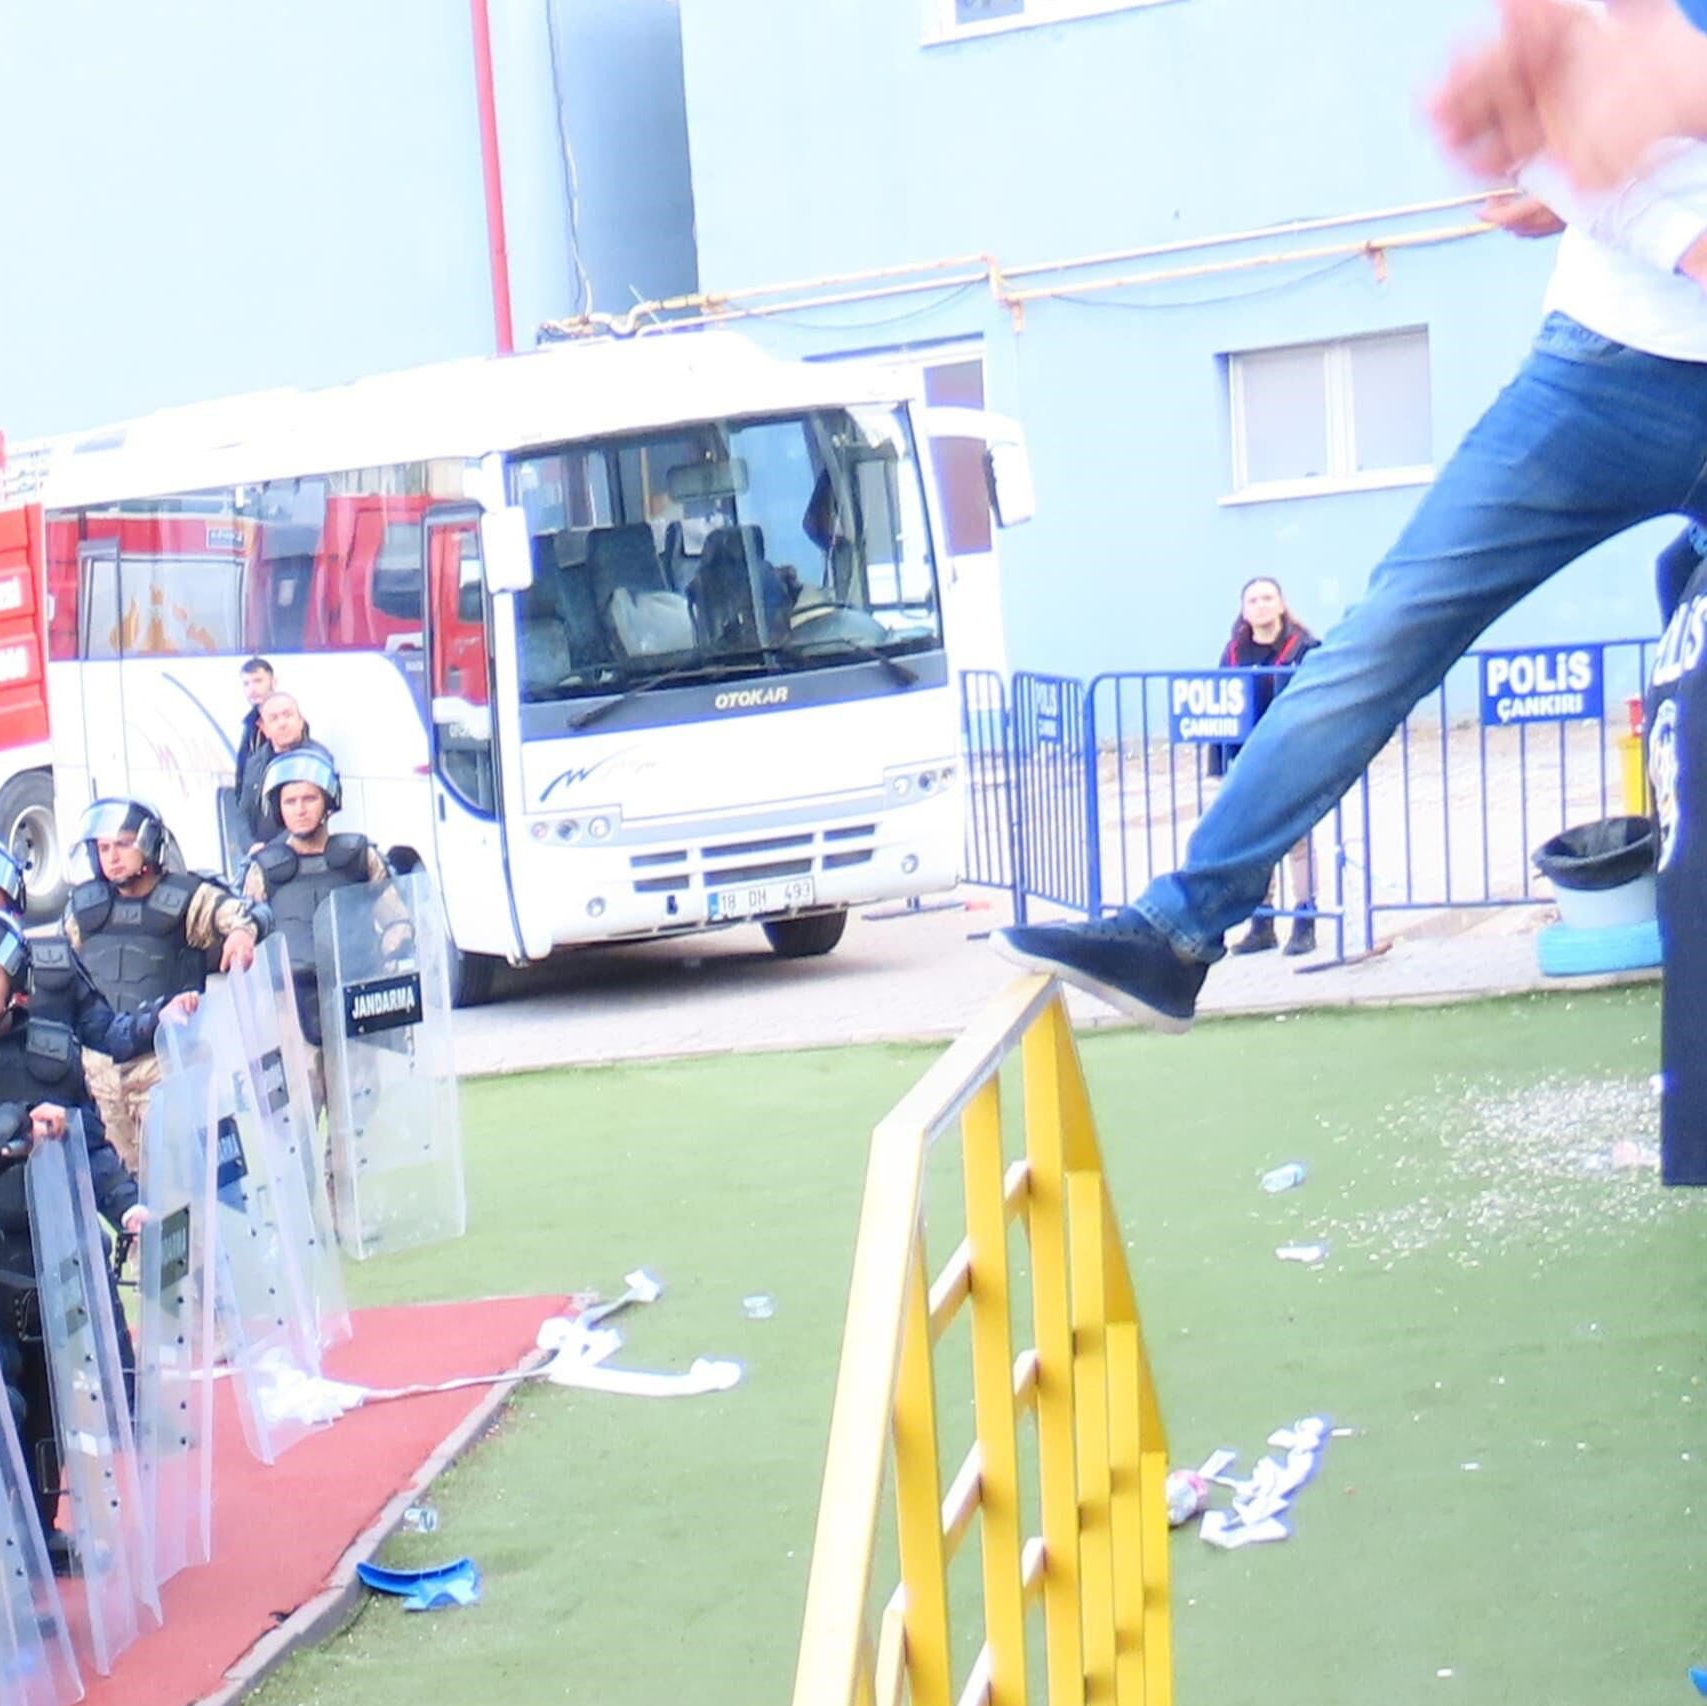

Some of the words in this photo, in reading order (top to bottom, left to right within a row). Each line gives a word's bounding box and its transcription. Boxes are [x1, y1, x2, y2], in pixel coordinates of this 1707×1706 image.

[1488, 650, 1591, 697] POLİS
[714, 685, 789, 710] OTOKAR
[1496, 693, 1583, 723] ÇANKIRI
[721, 894, 737, 912] 18
[351, 985, 416, 1020] JANDARMA
